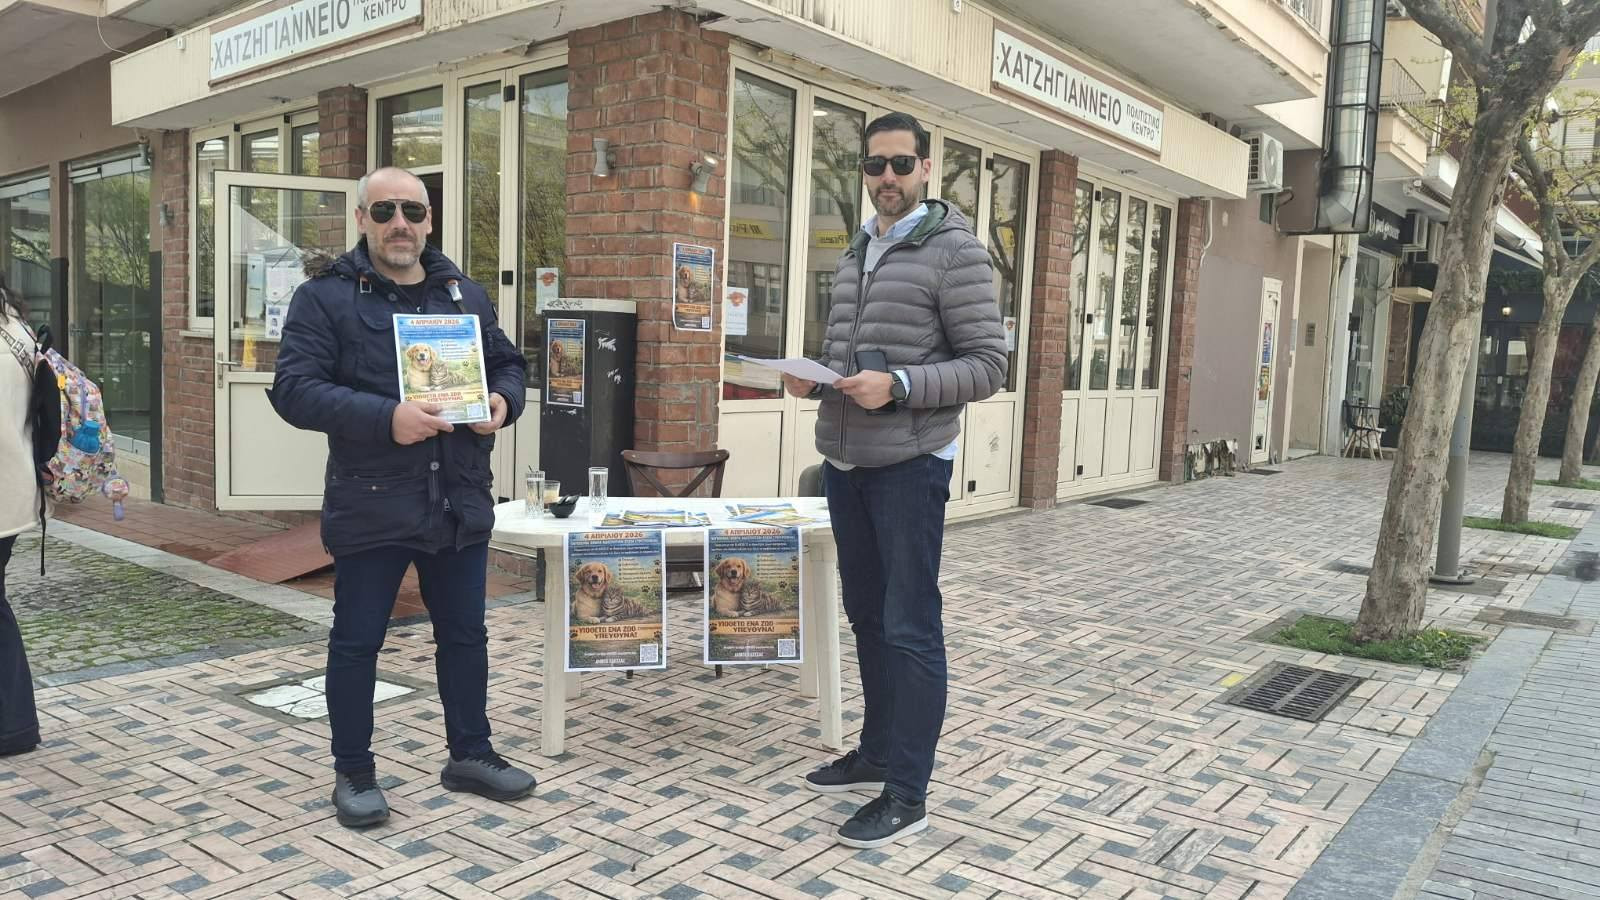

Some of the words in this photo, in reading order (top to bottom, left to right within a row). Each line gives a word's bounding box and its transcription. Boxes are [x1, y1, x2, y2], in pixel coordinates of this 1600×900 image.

[363, 0, 406, 22] ΚΕΝΤΡΟ
[214, 0, 350, 71] ΧΑΤΖΗΓΙΑΝΝΕΙΟ
[999, 42, 1121, 125] ΧΑΤΖΗΓΙΑΝΝΕΙΟ
[1126, 104, 1159, 129] ΠΟΛΙΤΙΣΤΙΚΟ
[1131, 120, 1154, 141] ΚΕΝΤΡΟ
[590, 532, 624, 540] ΑΠΡΙΛΙΟΥ
[625, 531, 644, 539] 2026
[762, 528, 781, 536] 2026
